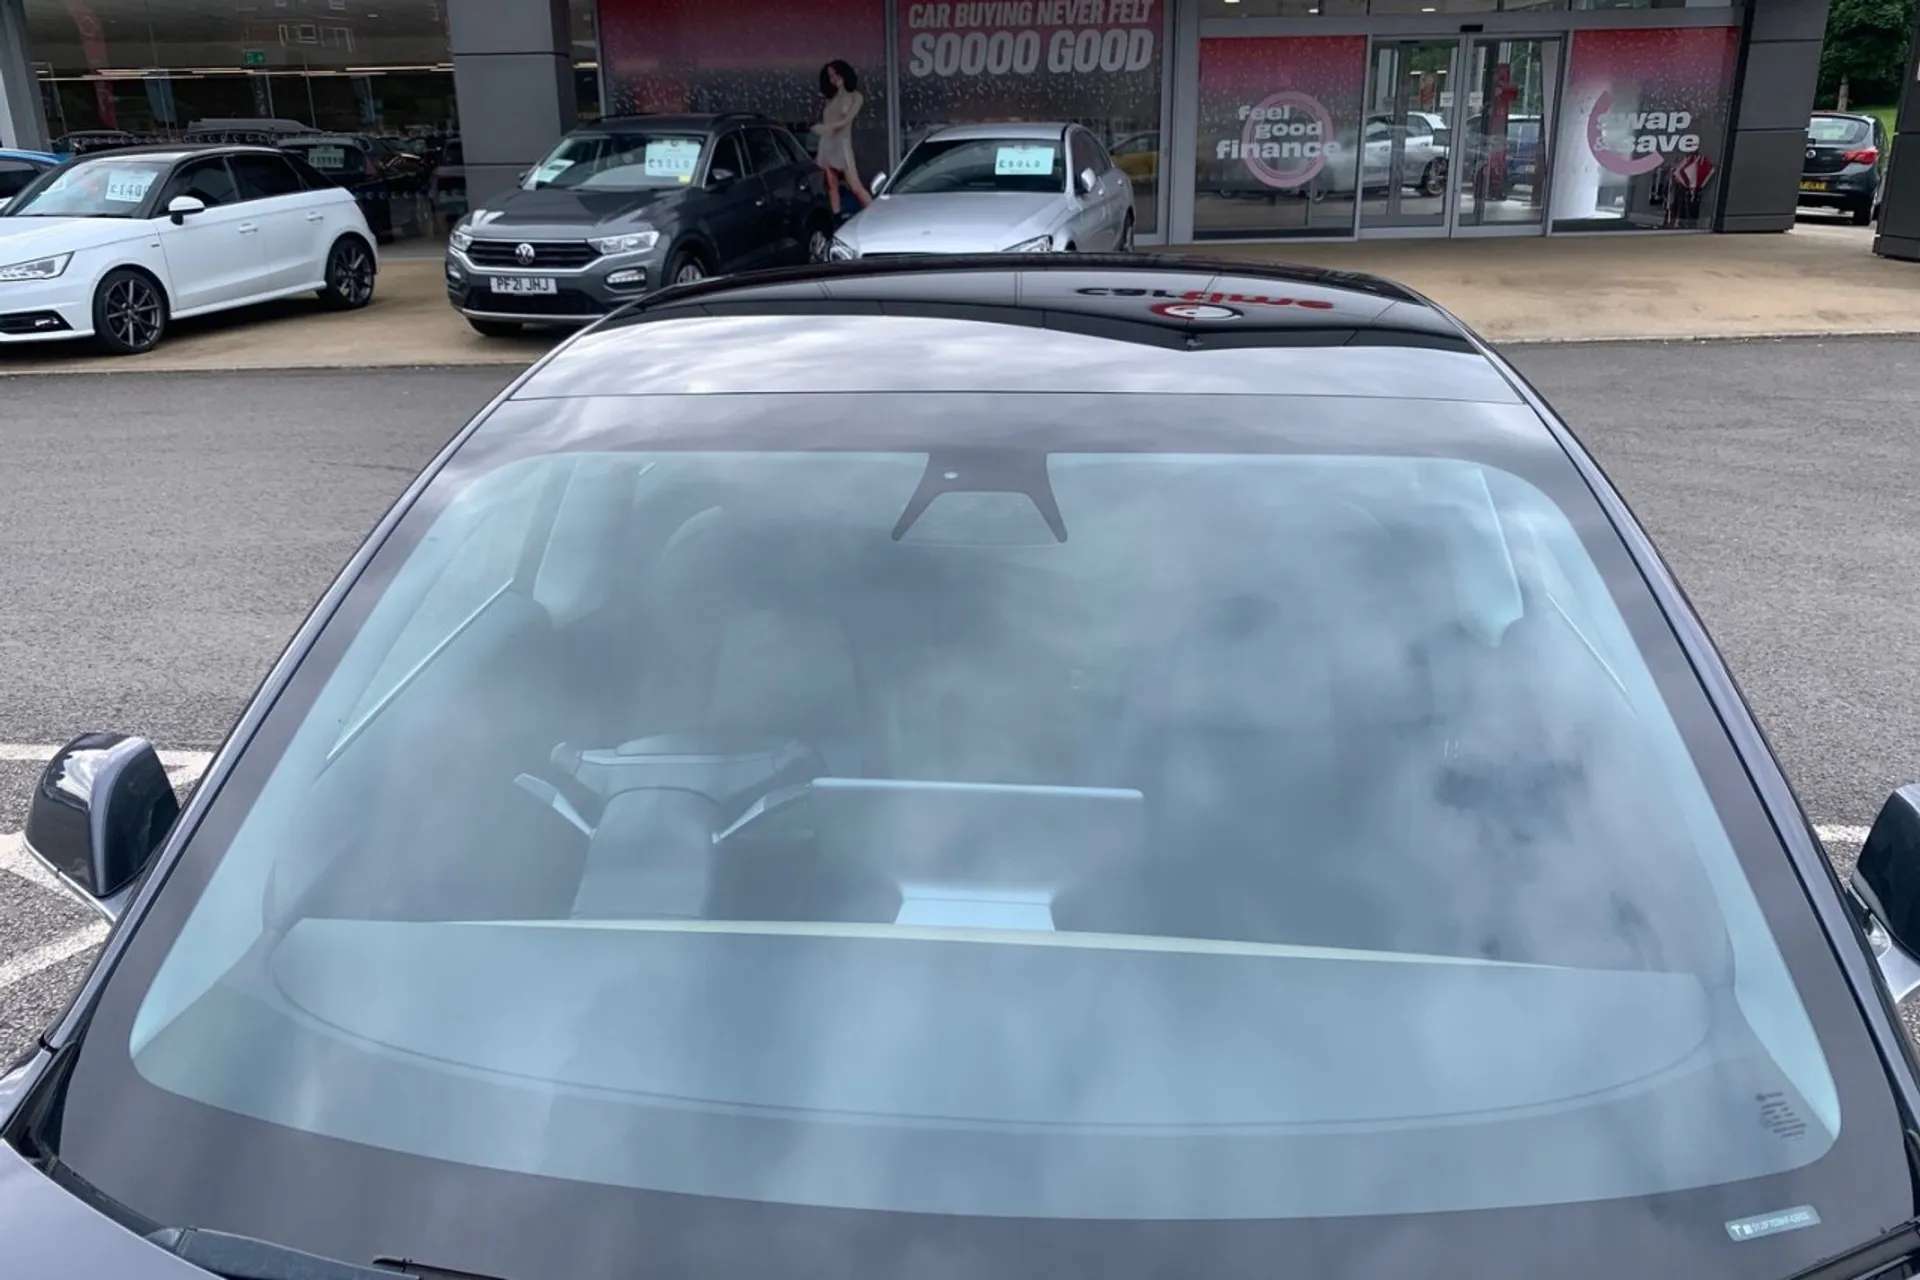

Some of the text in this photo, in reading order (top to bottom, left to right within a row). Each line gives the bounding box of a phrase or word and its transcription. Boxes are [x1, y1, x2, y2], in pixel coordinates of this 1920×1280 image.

[909, 0, 1151, 28] CAR BUYING NEVER FELT
[909, 28, 1154, 77] SOOOO GOOD
[1238, 105, 1291, 120] feel
[1254, 120, 1322, 139] good
[1216, 139, 1341, 159] finance
[497, 277, 550, 292] PF21 JHJ
